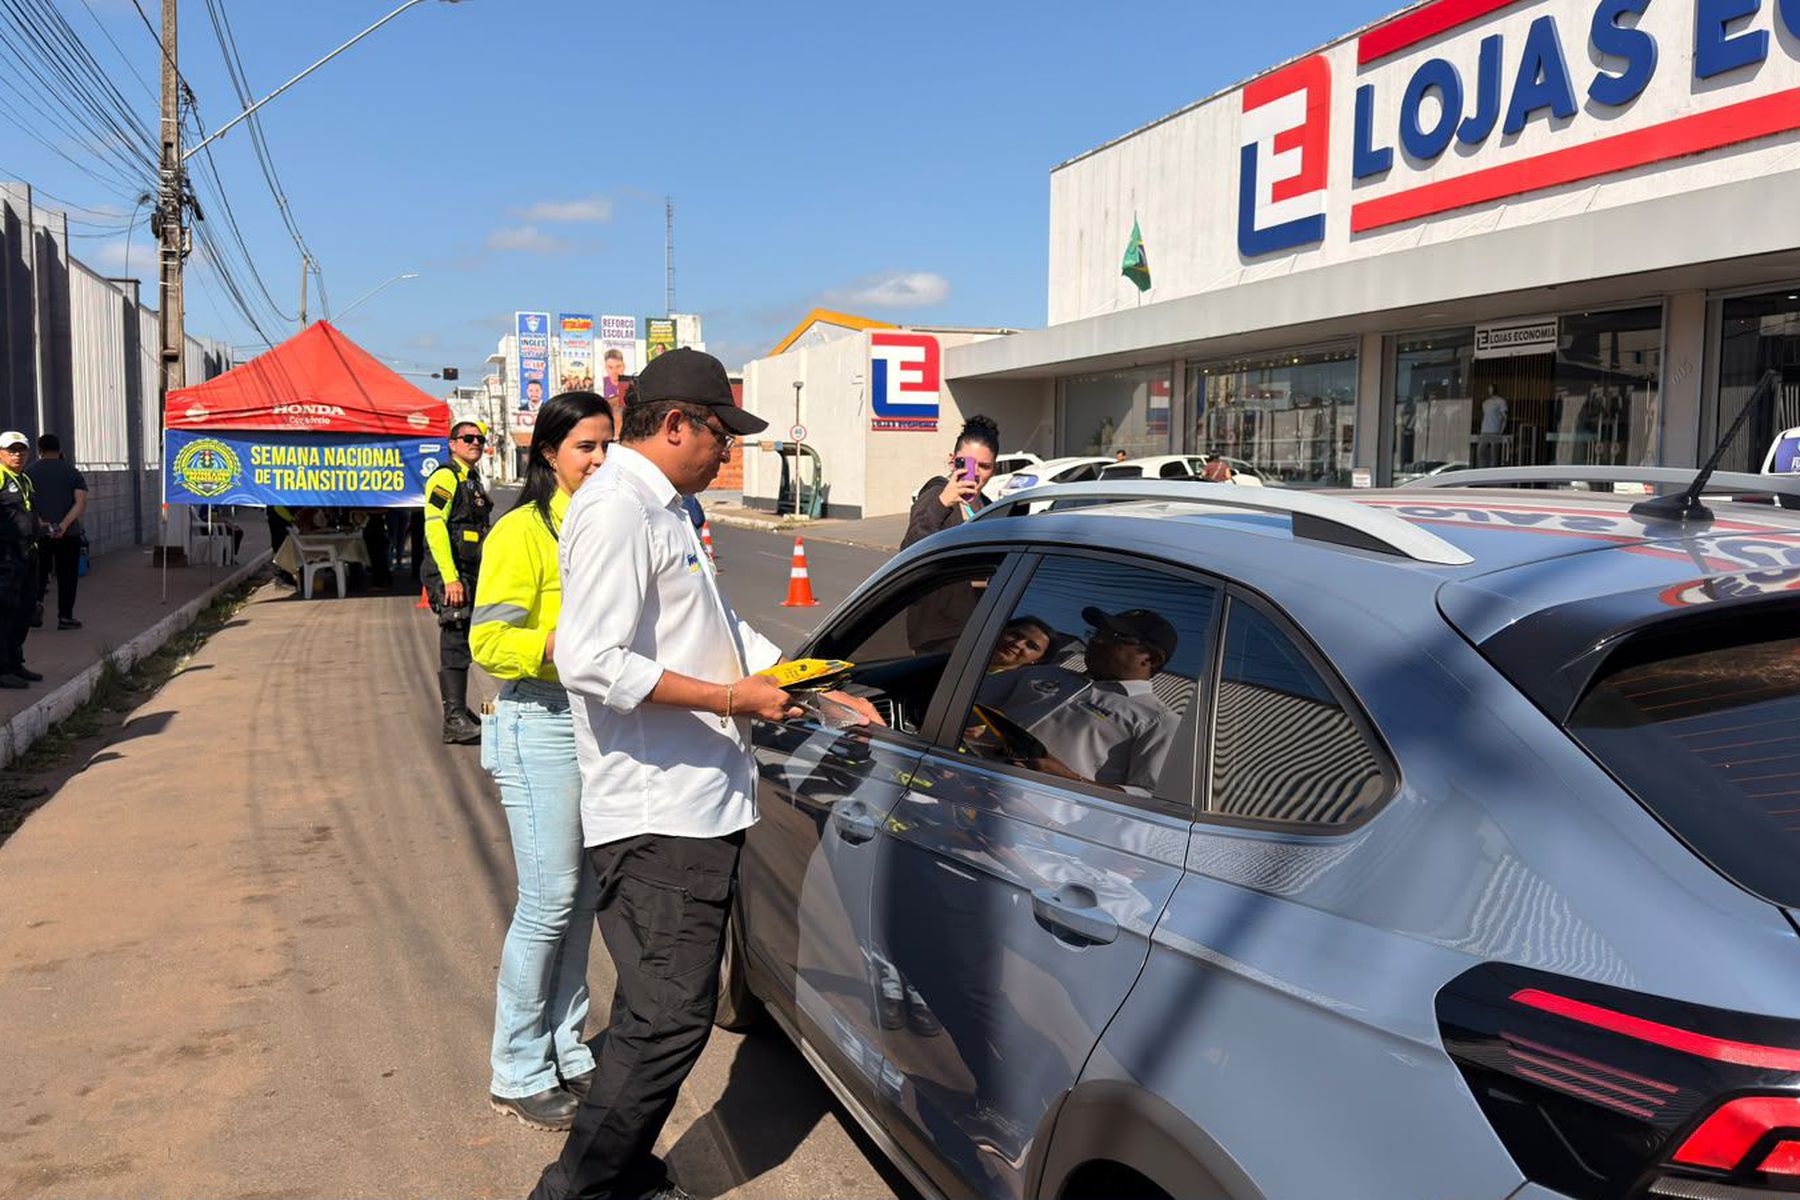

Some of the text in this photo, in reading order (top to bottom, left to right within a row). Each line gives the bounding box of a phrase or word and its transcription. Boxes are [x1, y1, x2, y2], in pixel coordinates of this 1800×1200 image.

[1353, 0, 1659, 179] LOJAS
[1513, 326, 1556, 342] ECONOMIA
[272, 404, 346, 416] HONDA
[250, 446, 321, 467] SEMANA
[324, 447, 405, 468] NACIONAL
[255, 468, 271, 485] DE
[272, 466, 358, 491] TRÂNSITO
[359, 470, 405, 491] 2026
